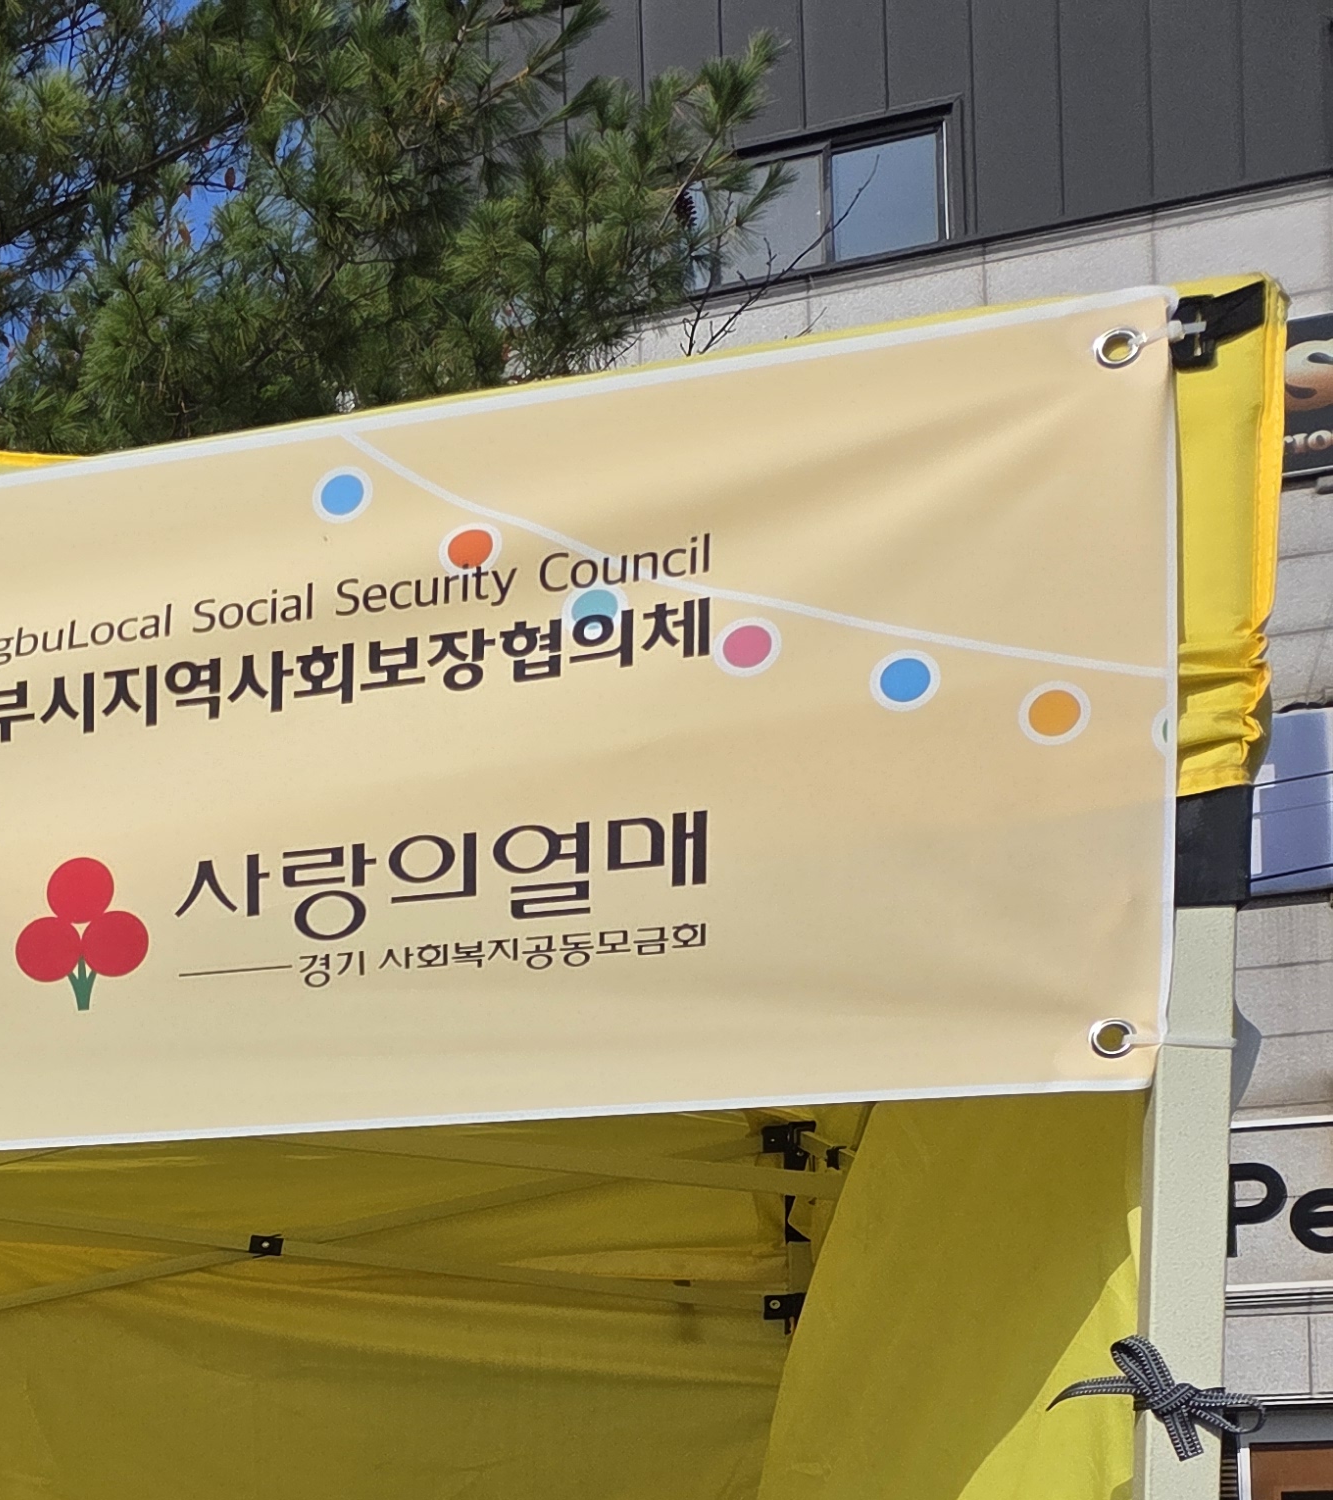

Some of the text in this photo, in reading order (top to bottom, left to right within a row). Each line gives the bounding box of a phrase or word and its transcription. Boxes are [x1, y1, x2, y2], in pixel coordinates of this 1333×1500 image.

[192, 583, 314, 636] Social
[335, 560, 516, 619] Security
[538, 533, 710, 591] Council
[174, 809, 708, 941] 사랑의열매
[298, 921, 707, 989] 경기 사회복지공동모금회
